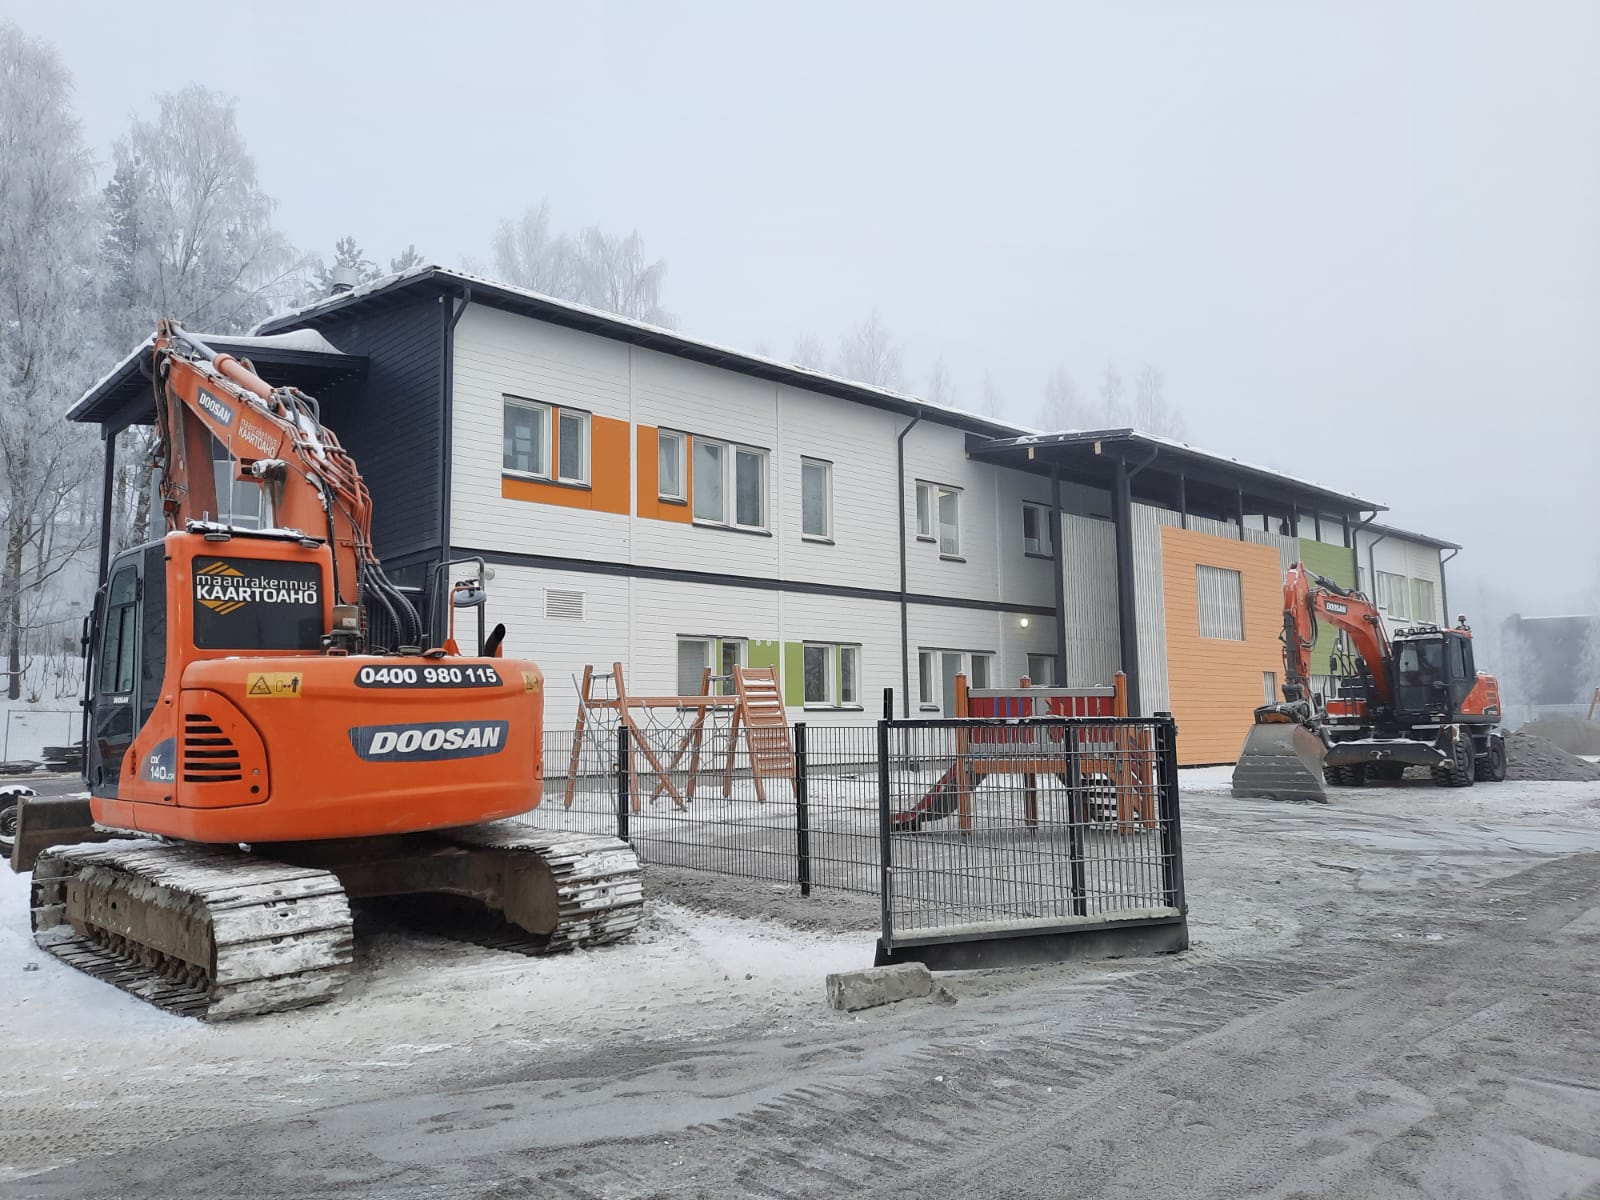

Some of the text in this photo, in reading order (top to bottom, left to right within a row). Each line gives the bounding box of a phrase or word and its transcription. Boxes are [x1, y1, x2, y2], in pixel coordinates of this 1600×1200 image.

[199, 392, 231, 424] DOOSAN
[238, 425, 276, 458] KAARTOAHO
[196, 575, 317, 591] maanrakennus
[196, 585, 318, 604] KAARTOAHO
[360, 667, 497, 684] 0400 980 115
[368, 726, 501, 755] DOOSAN
